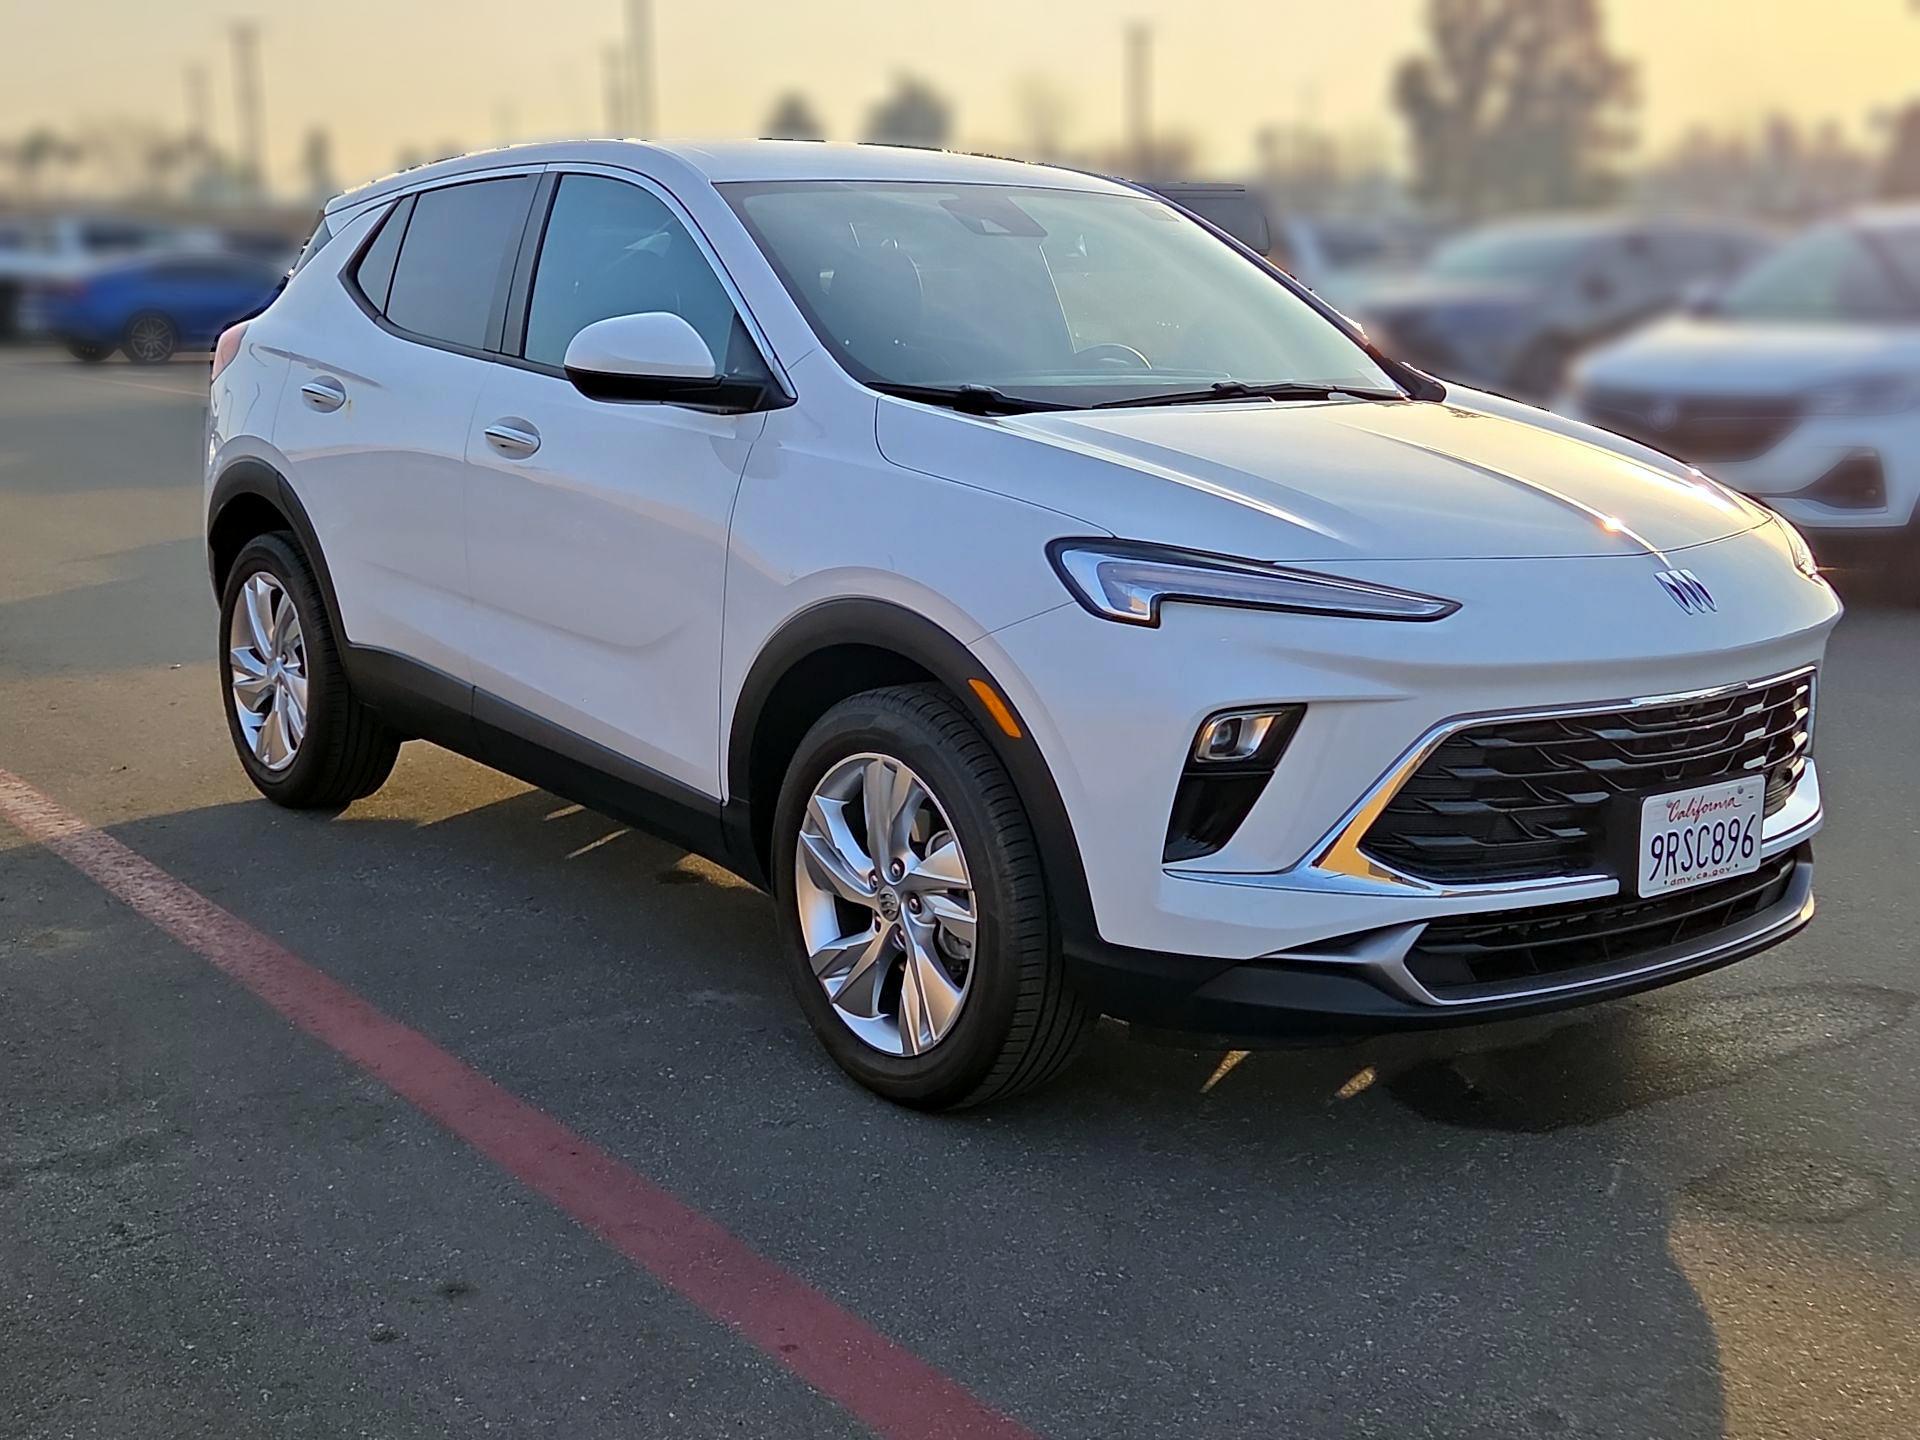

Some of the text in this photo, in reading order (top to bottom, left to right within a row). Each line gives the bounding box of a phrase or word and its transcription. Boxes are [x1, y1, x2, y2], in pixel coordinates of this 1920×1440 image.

[1667, 795, 1742, 824] California
[1649, 814, 1756, 881] 9RSC896
[1670, 866, 1732, 886] dmv.ca.gov
